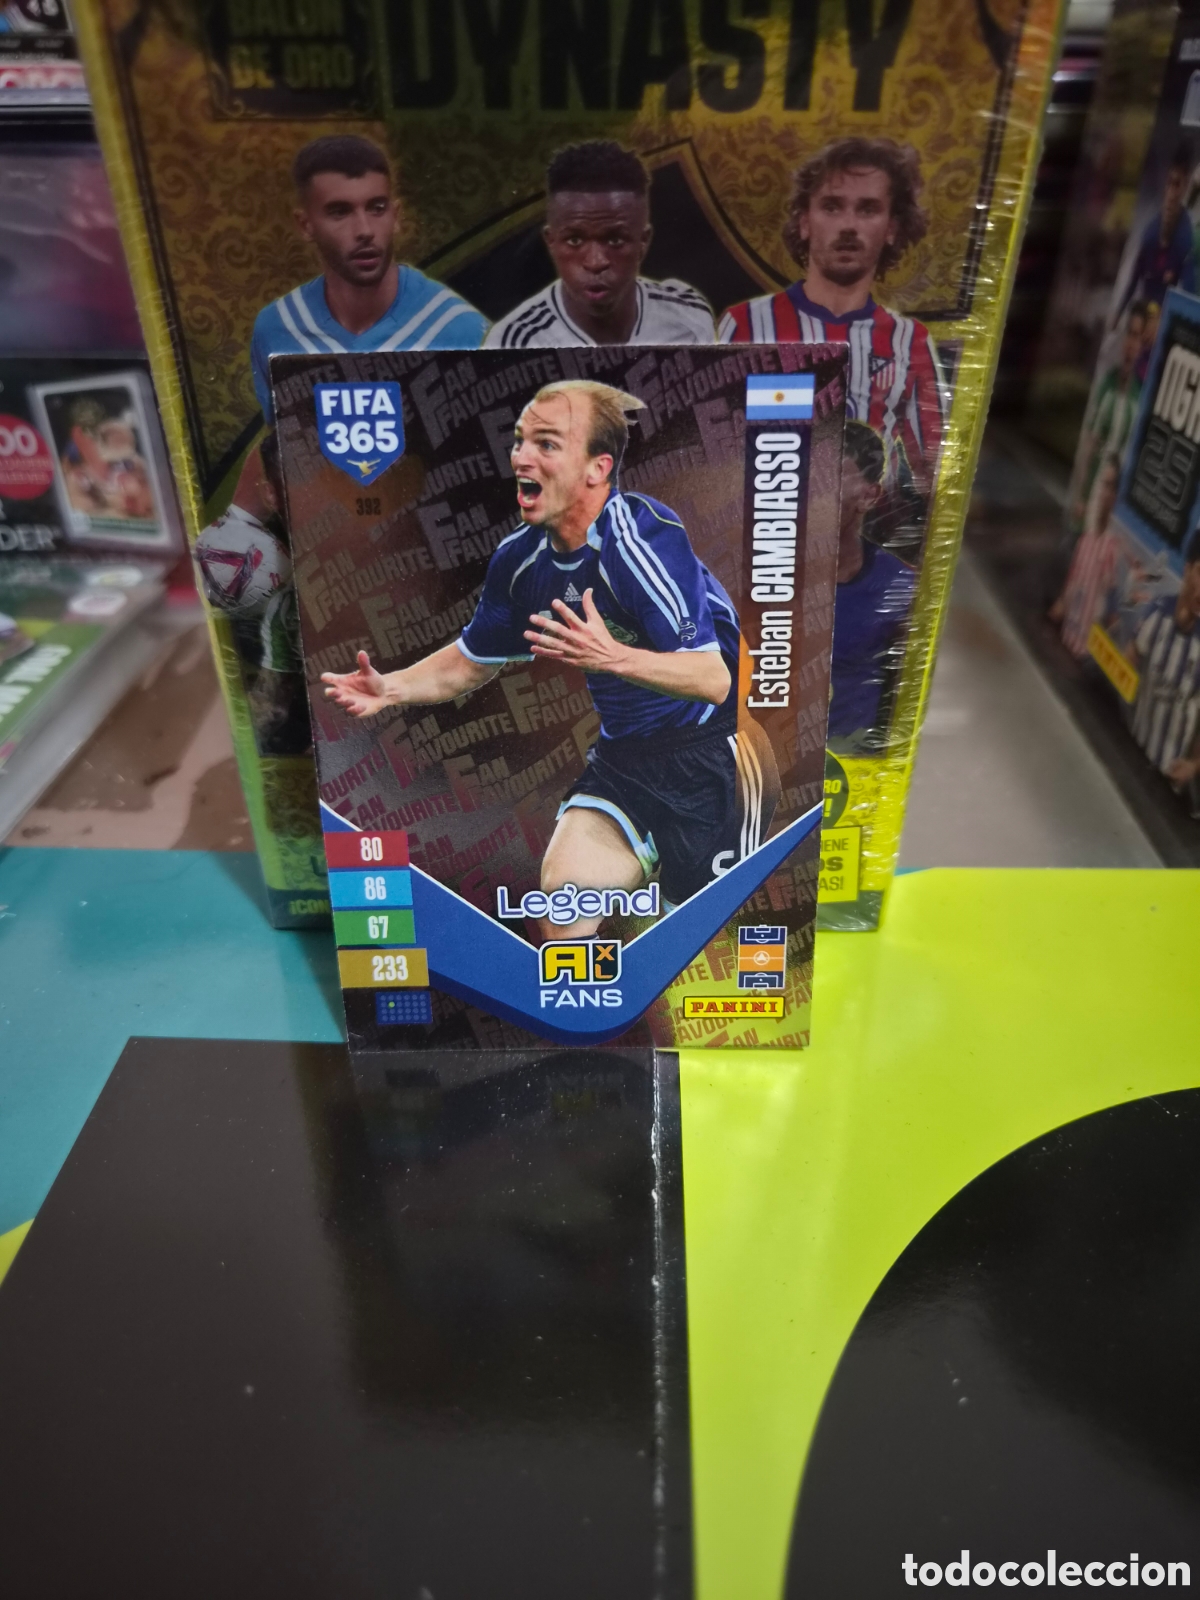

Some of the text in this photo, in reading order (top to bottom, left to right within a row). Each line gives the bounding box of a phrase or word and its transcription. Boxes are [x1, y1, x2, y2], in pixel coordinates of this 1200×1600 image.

[229, 44, 275, 89] DE
[320, 388, 396, 416] FIFA
[325, 420, 399, 454] 365
[356, 498, 381, 516] 392
[748, 432, 801, 707] Esteban CAMBIASSO
[360, 837, 383, 861] 80
[364, 877, 387, 900] 86
[498, 883, 660, 924] Legend
[367, 915, 389, 938] 67
[371, 956, 408, 982] 233
[540, 989, 623, 1008] FANS
[690, 1001, 778, 1013] PANINI
